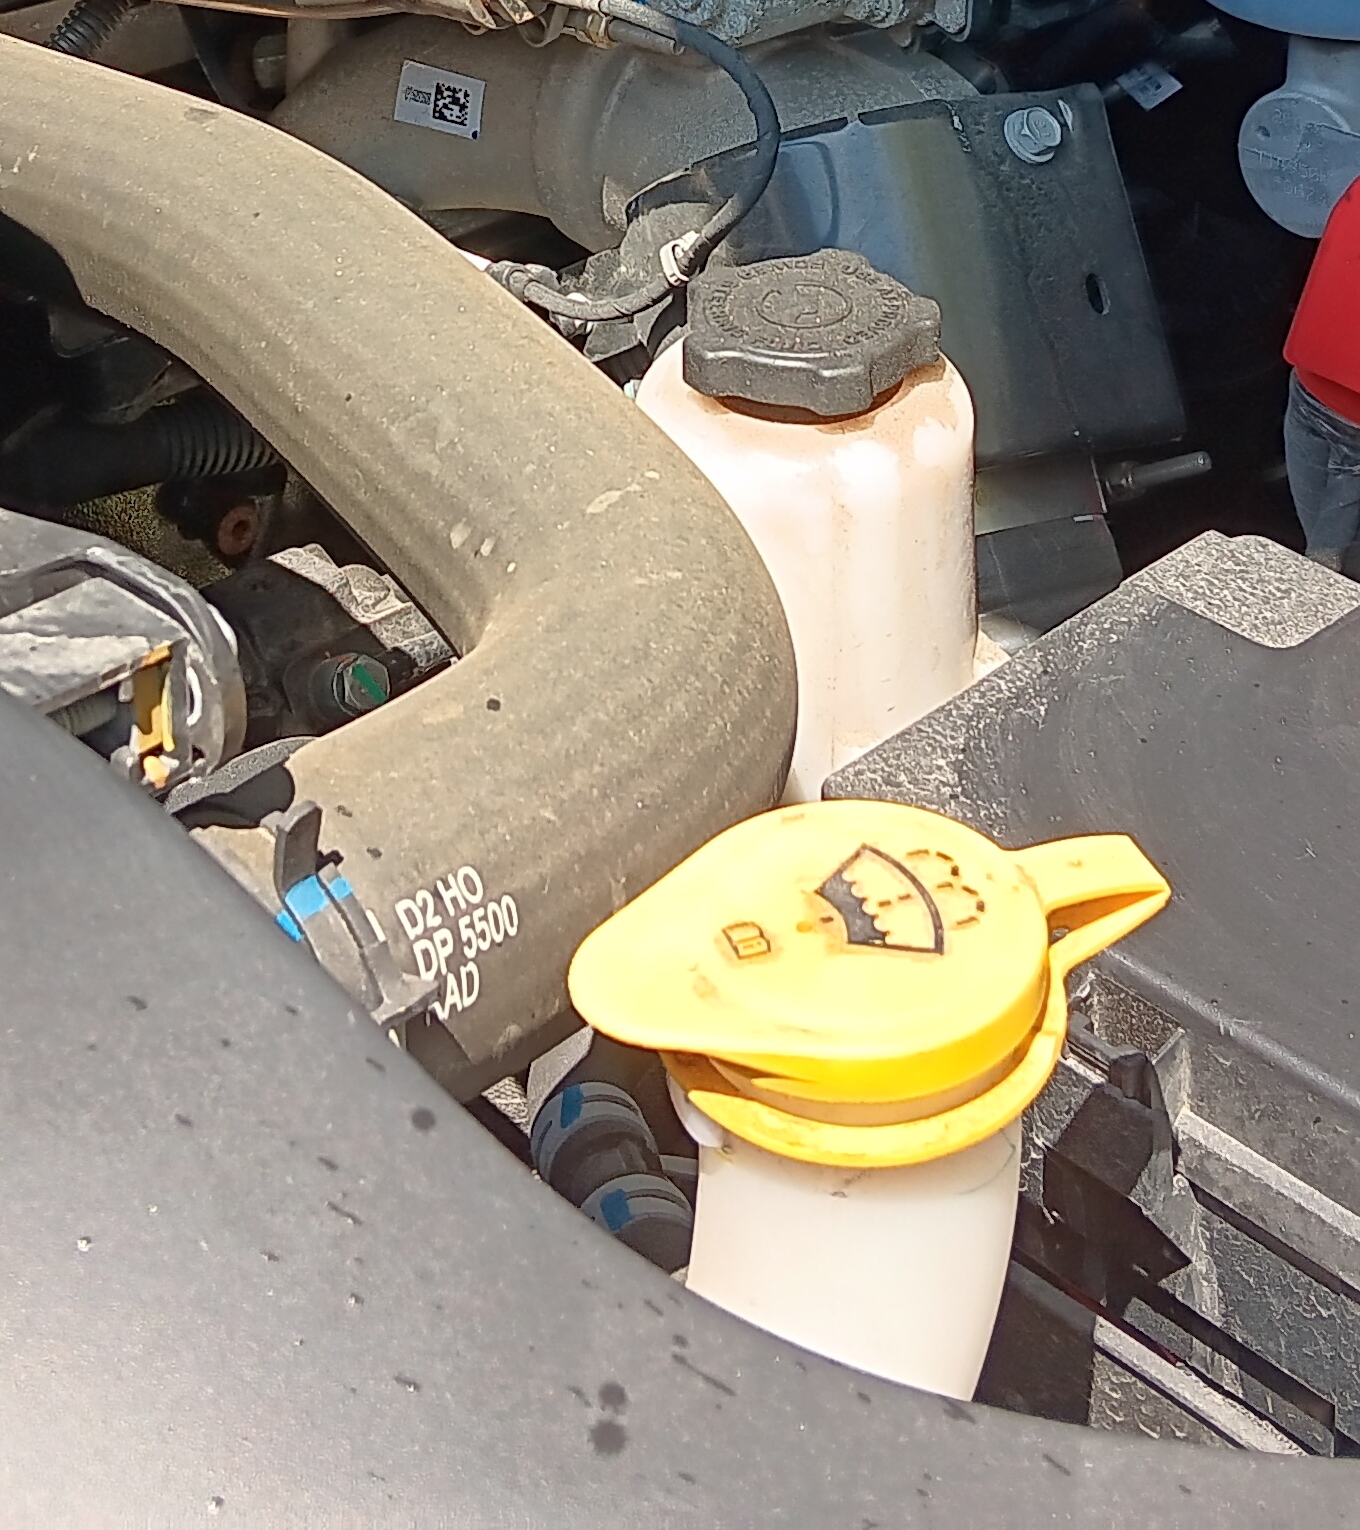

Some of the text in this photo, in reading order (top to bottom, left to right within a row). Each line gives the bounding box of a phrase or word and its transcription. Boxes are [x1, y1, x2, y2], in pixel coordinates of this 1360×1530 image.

[396, 865, 485, 940] D2 HO
[413, 895, 520, 982] DP 5500
